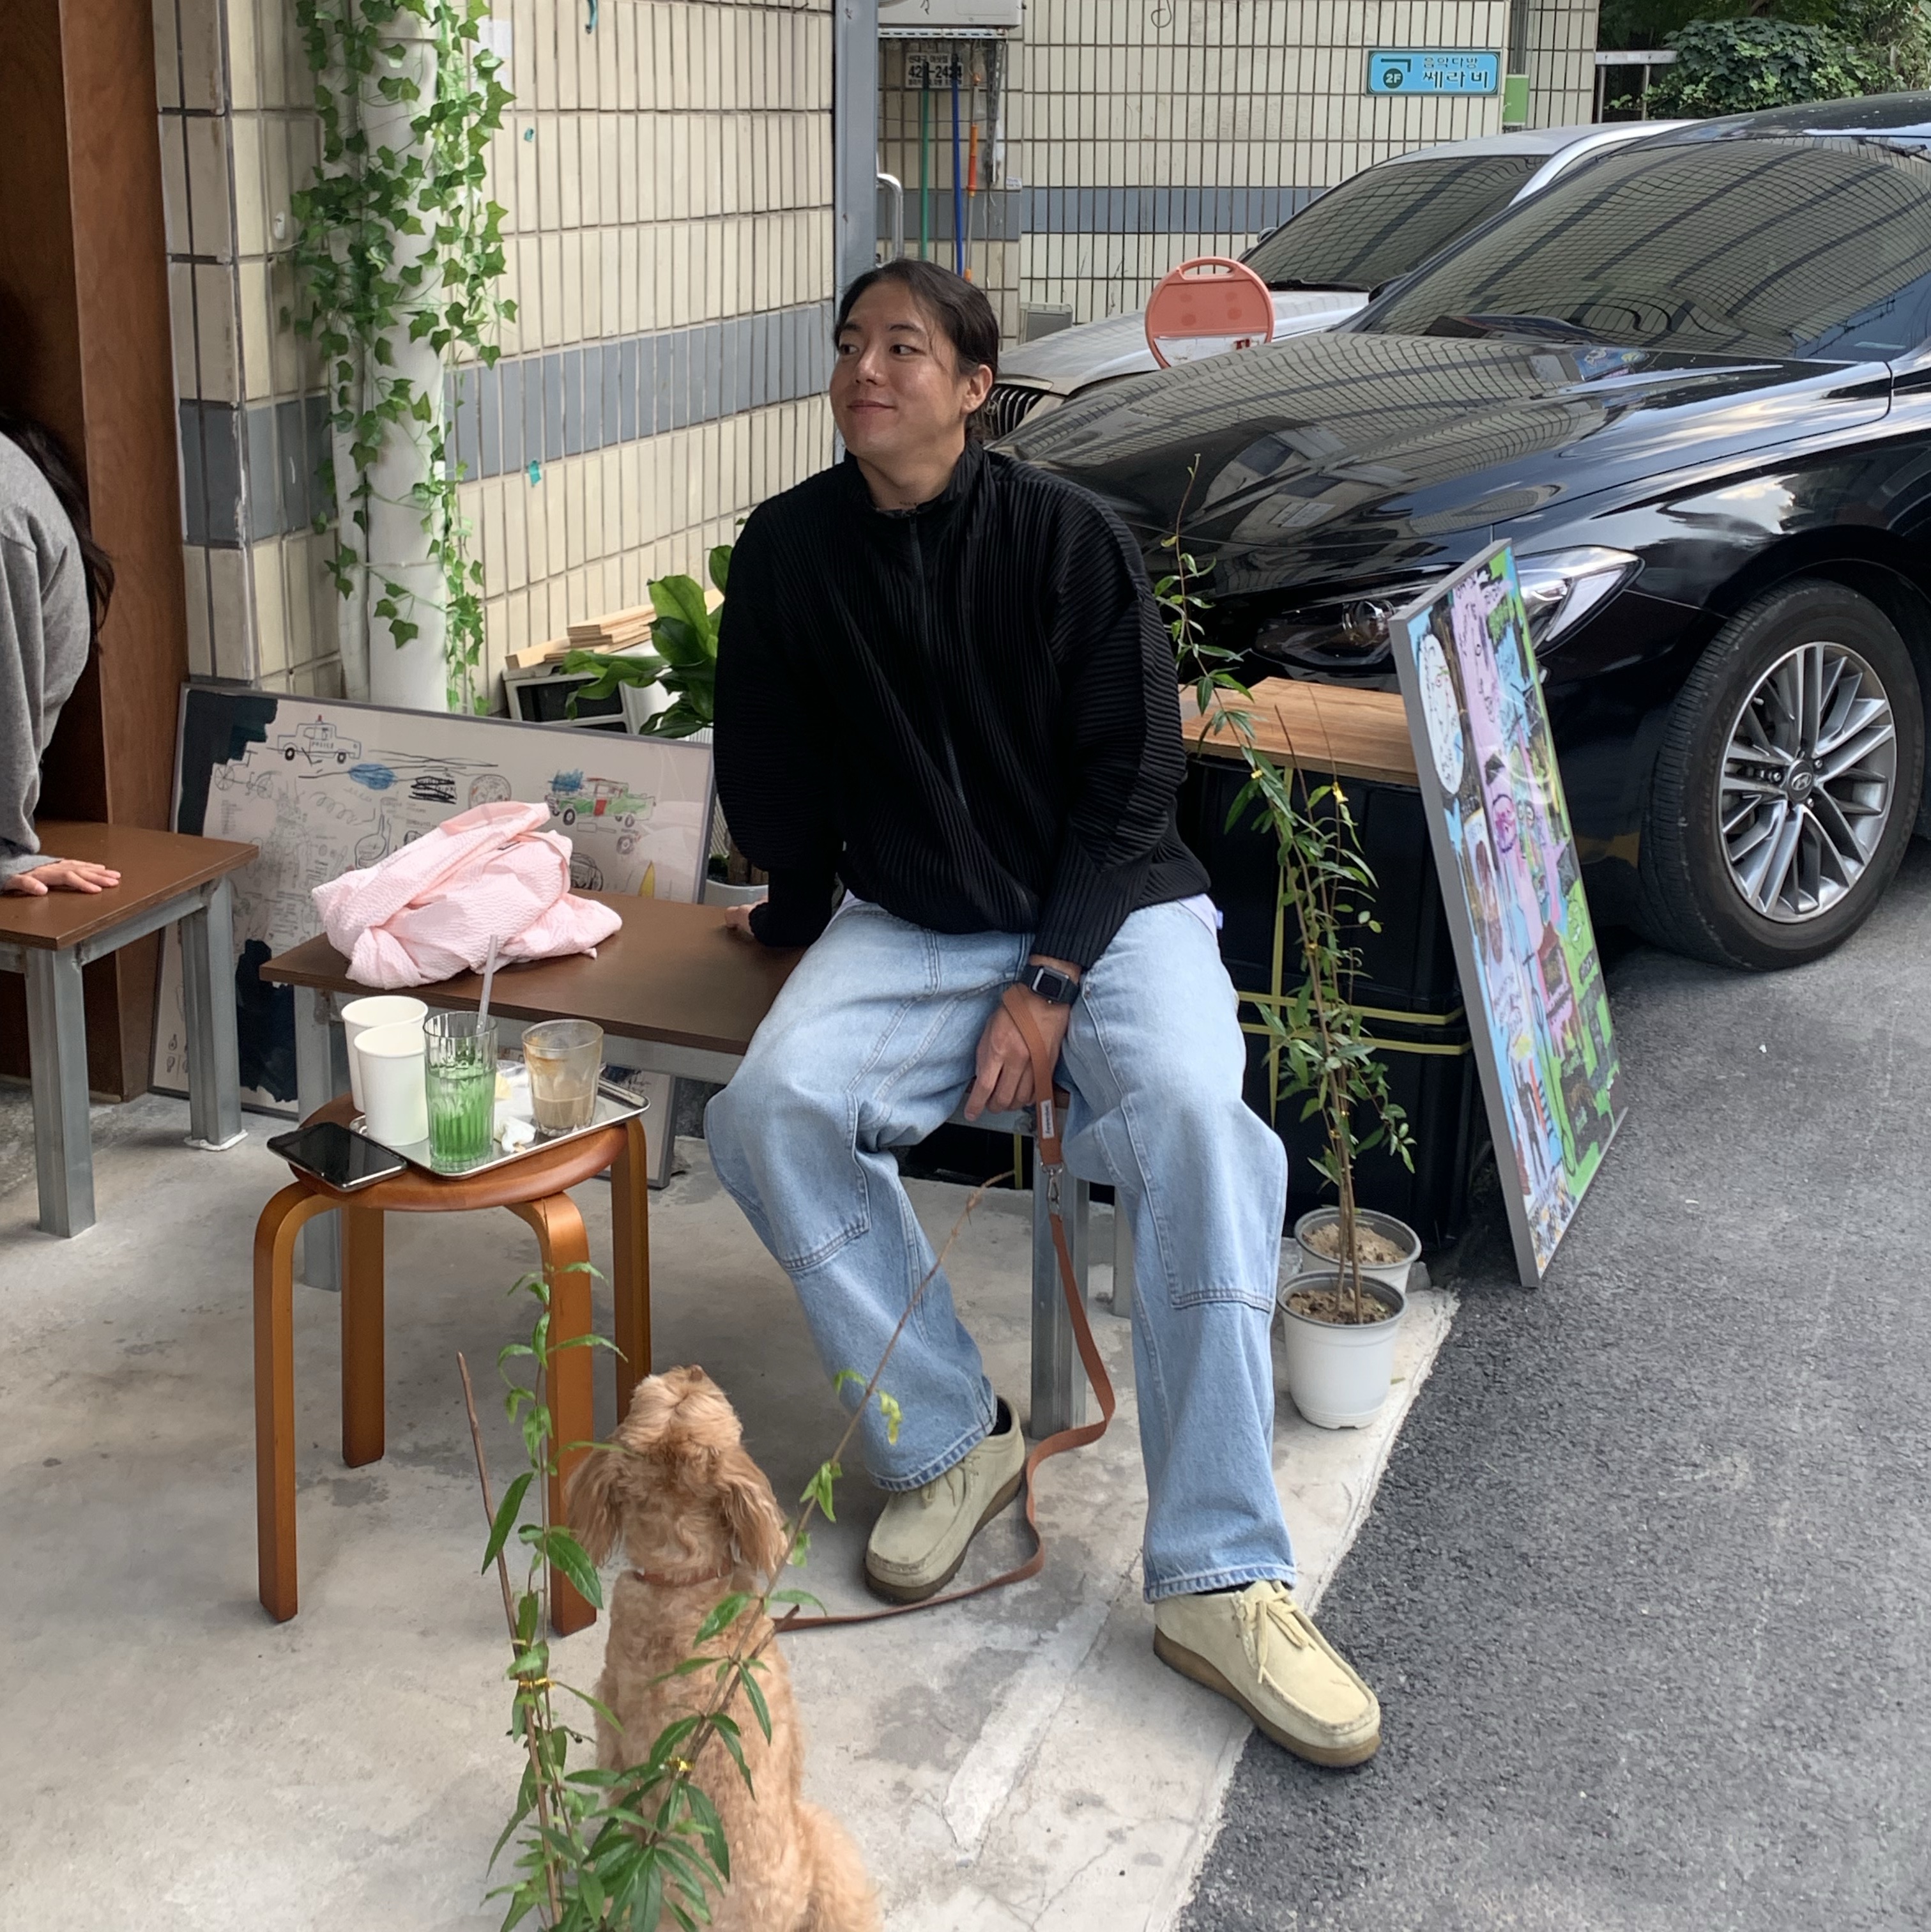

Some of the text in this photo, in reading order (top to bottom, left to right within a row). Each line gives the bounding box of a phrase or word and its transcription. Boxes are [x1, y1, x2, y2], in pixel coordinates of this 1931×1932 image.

[1423, 57, 1478, 69] 음악다방
[1385, 74, 1401, 83] 2F
[1422, 71, 1488, 89] 쎄라비
